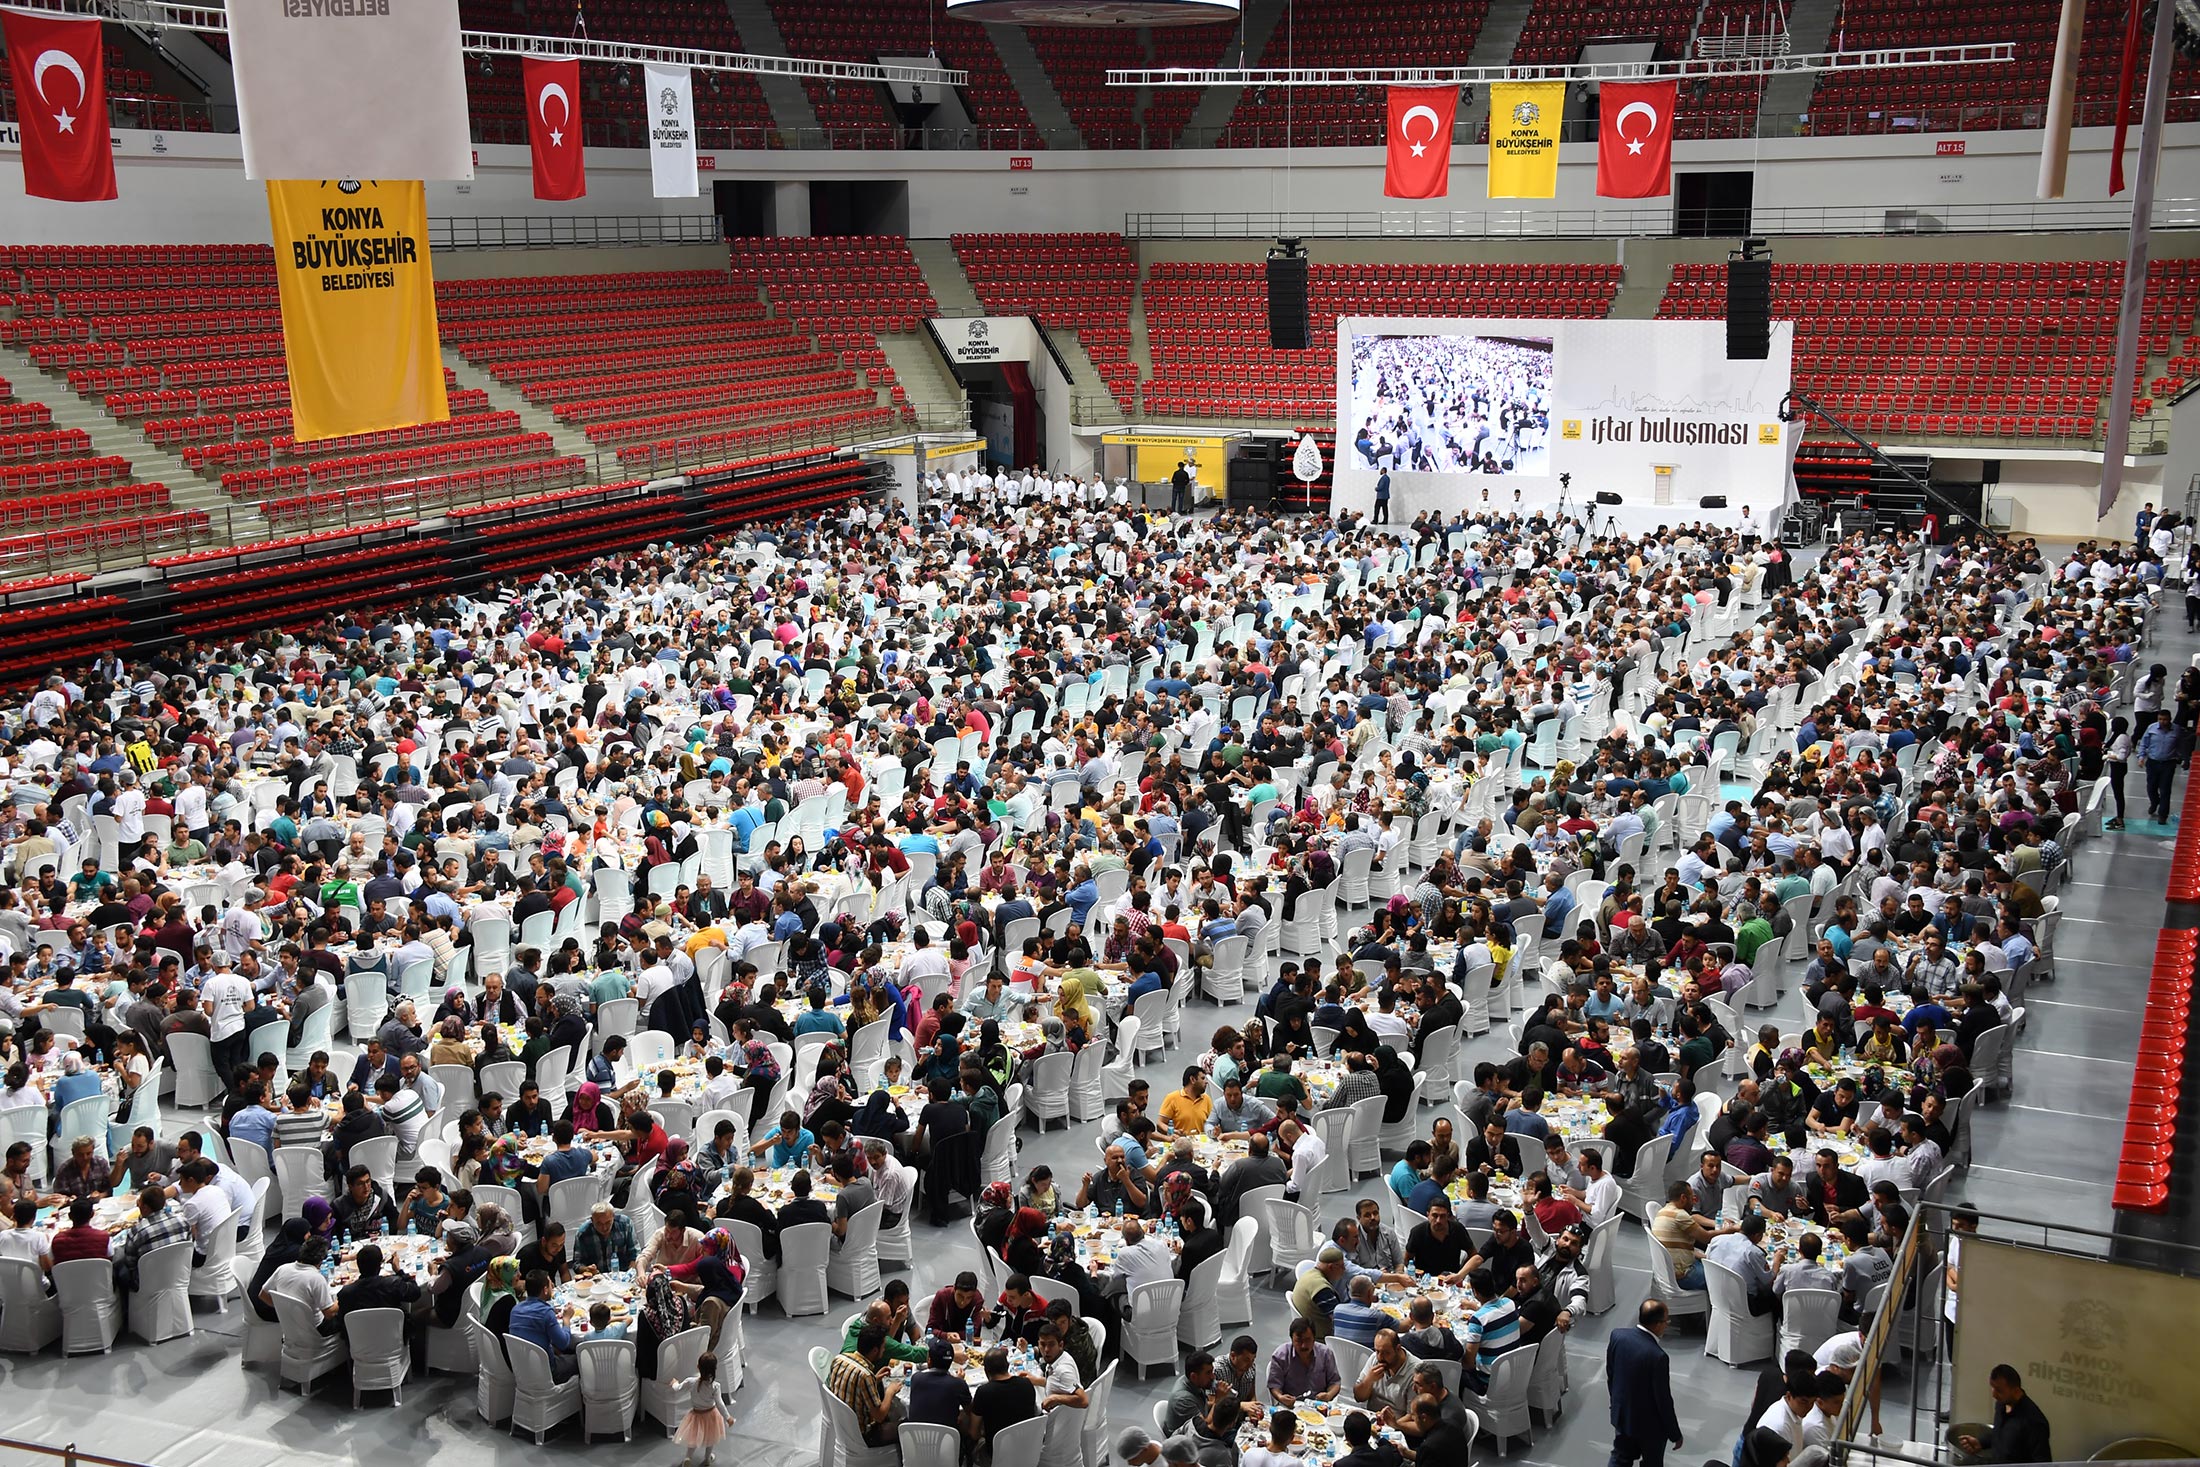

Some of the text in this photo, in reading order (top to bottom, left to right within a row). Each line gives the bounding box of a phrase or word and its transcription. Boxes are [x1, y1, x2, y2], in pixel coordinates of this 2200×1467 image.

[653, 128, 689, 140] BÜYÜKŞEHİR
[1496, 137, 1553, 149] BÜYÜKŞEHİR
[1938, 144, 1964, 152] ALT 15
[705, 159, 715, 167] 12
[1011, 160, 1032, 168] ALT 13
[322, 207, 384, 230] KONYA
[293, 231, 417, 270] BÜYÜKŞEHİR
[322, 267, 395, 291] BELEDİYESİ
[957, 346, 1000, 355] BÜYÜKŞEHİR
[1592, 416, 1749, 446] iftar buluşması
[1873, 1260, 1890, 1271] ÖZEL
